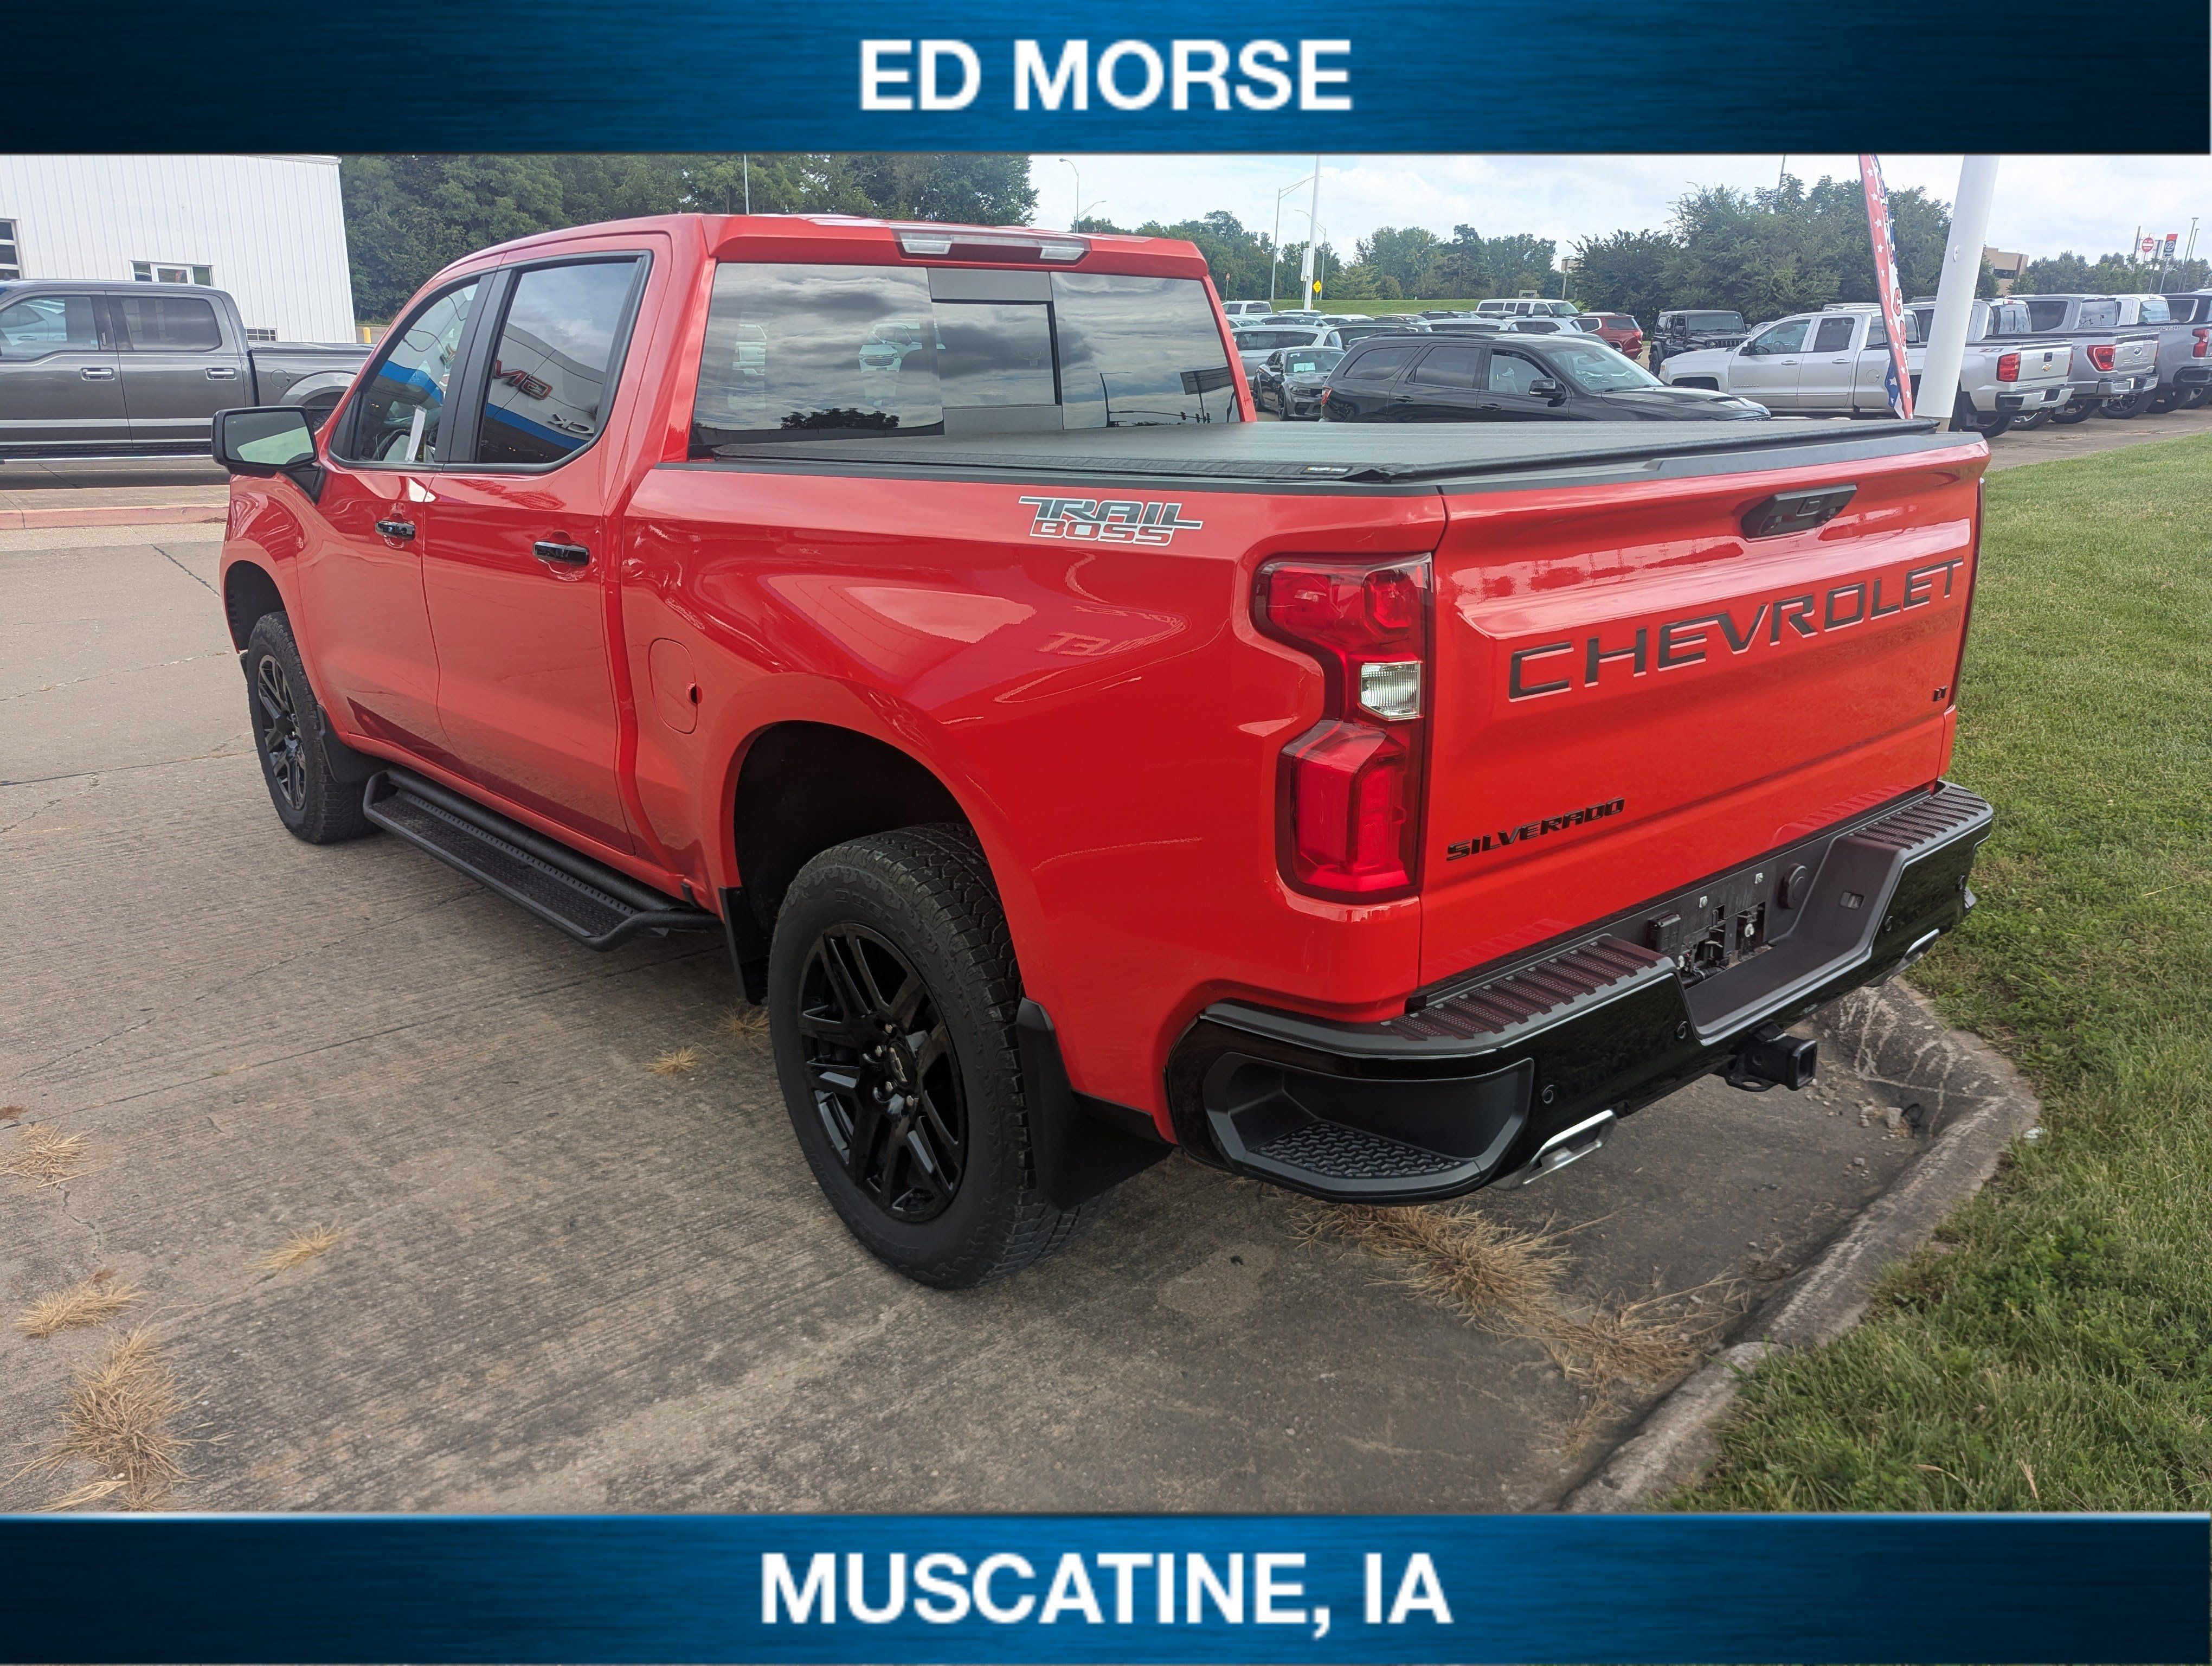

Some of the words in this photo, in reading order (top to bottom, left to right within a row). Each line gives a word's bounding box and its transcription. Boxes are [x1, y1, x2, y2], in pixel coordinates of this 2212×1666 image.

[1018, 496, 1204, 530] TRAIL
[1030, 519, 1175, 546] BOSS
[1509, 557, 1964, 702] CHEVROLET
[1933, 685, 1949, 702] LT
[1446, 797, 1625, 861] SILVERADO
